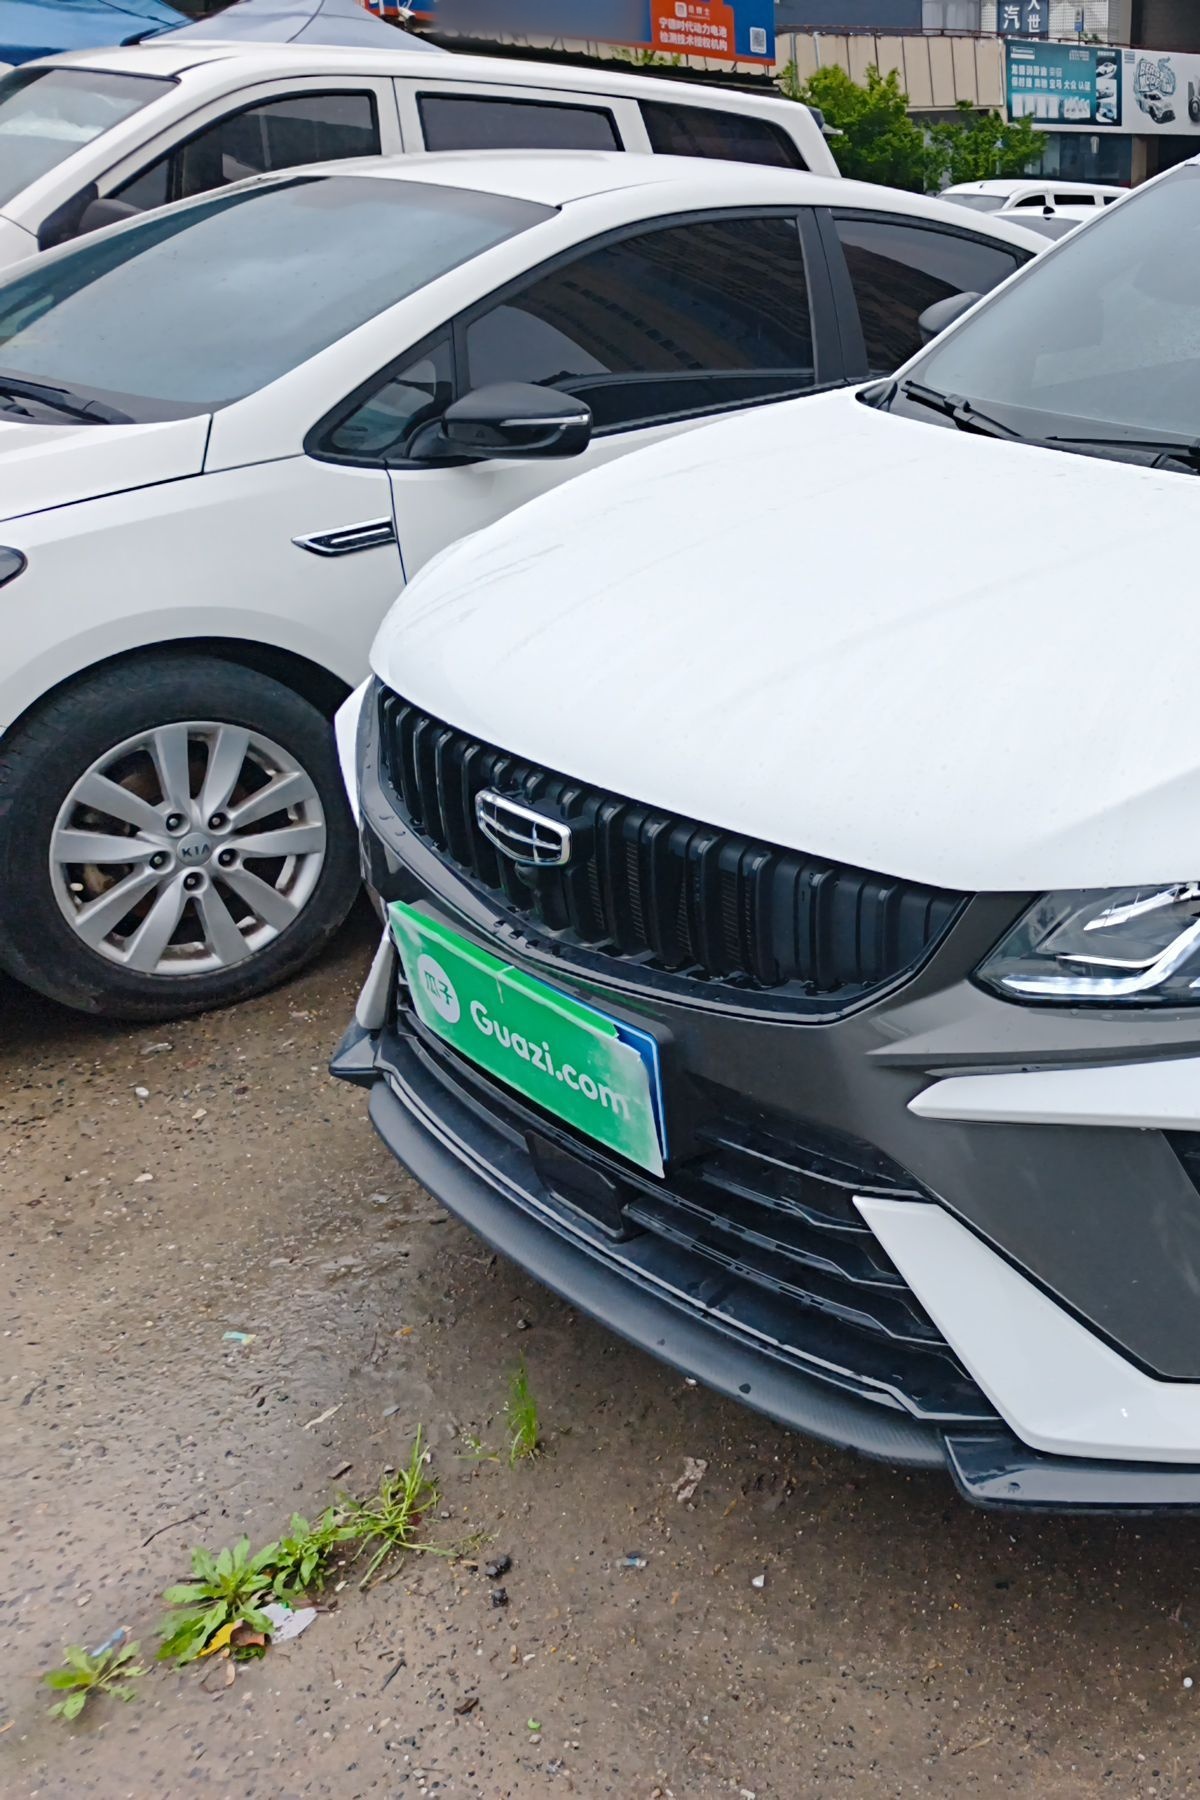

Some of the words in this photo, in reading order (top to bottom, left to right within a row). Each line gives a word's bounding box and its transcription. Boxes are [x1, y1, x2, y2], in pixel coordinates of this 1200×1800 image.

[658, 17, 728, 38] 宁德时代动力电池
[181, 843, 210, 857] KIA
[424, 969, 453, 1005] 瓜子
[470, 999, 631, 1120] Guazi.com
